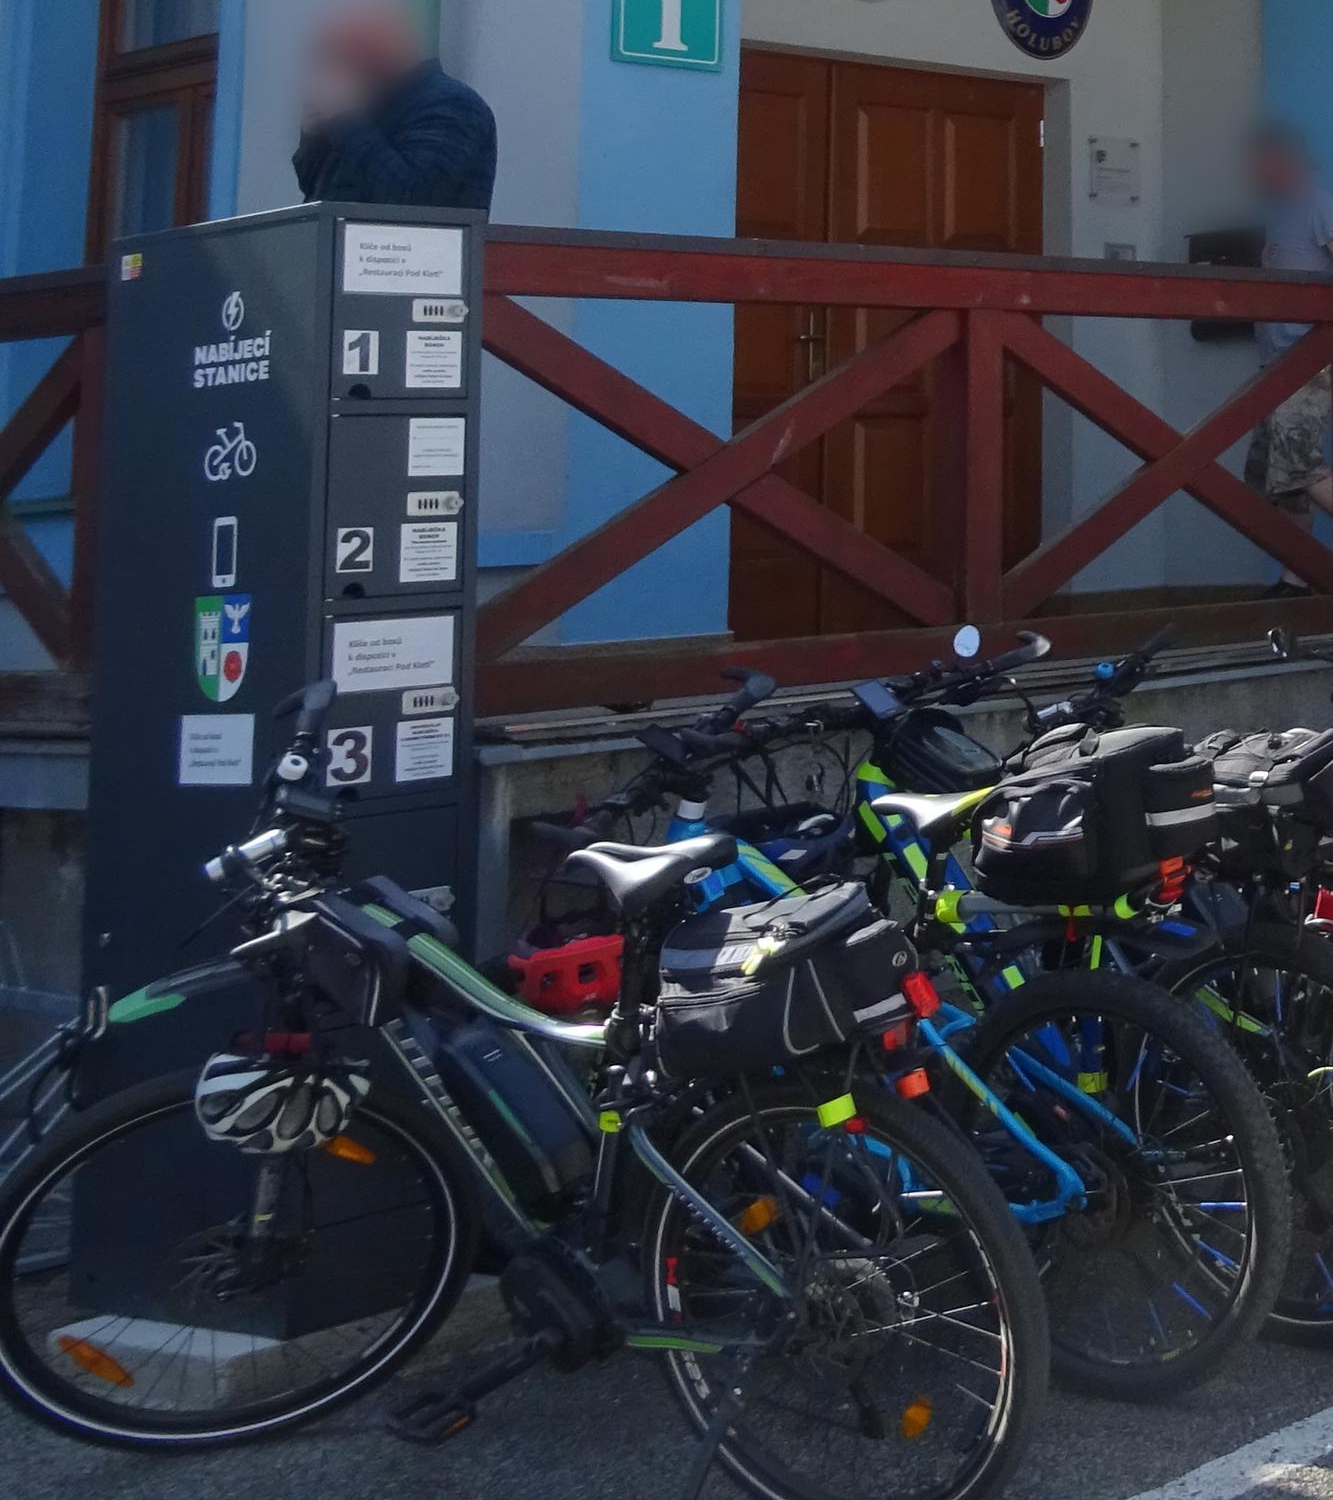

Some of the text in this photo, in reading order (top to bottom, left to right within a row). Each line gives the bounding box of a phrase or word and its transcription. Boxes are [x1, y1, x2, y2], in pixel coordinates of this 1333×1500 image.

[194, 329, 272, 366] NABÍJECÍ
[347, 331, 371, 374] 1
[193, 360, 271, 389] STANICE
[338, 529, 372, 572] 2
[329, 729, 369, 783] 3
